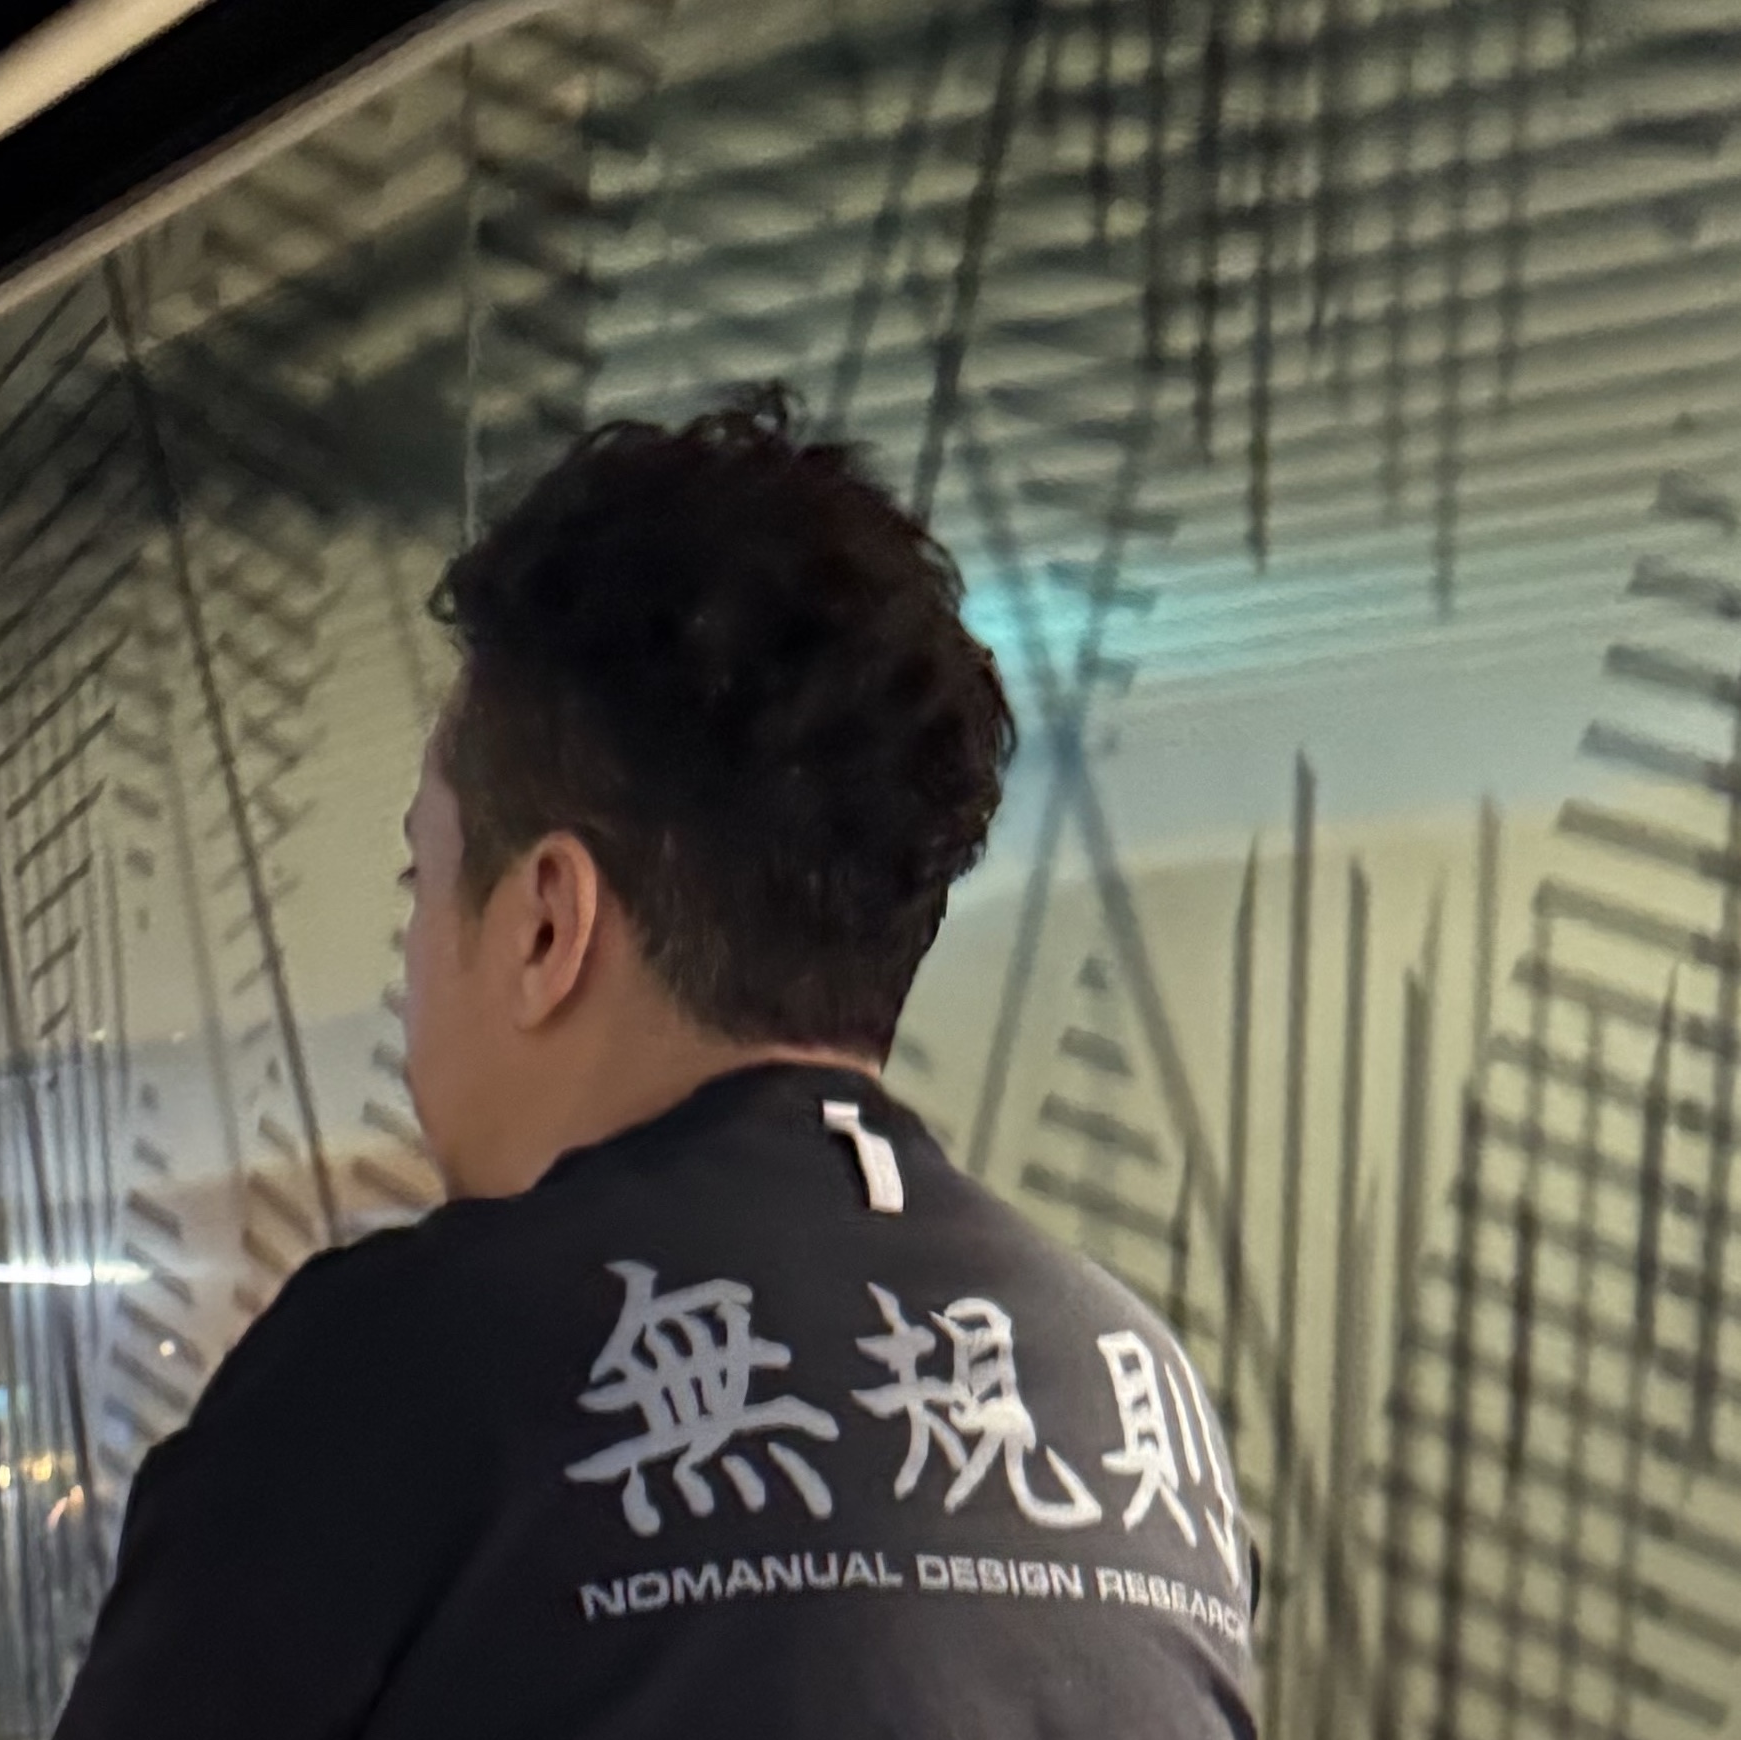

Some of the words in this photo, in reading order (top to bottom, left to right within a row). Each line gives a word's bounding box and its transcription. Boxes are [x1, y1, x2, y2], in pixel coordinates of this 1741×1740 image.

[565, 1259, 1240, 1590] 無規則
[579, 1551, 904, 1622] NOMANUAL
[915, 1553, 1085, 1600] DESIGN
